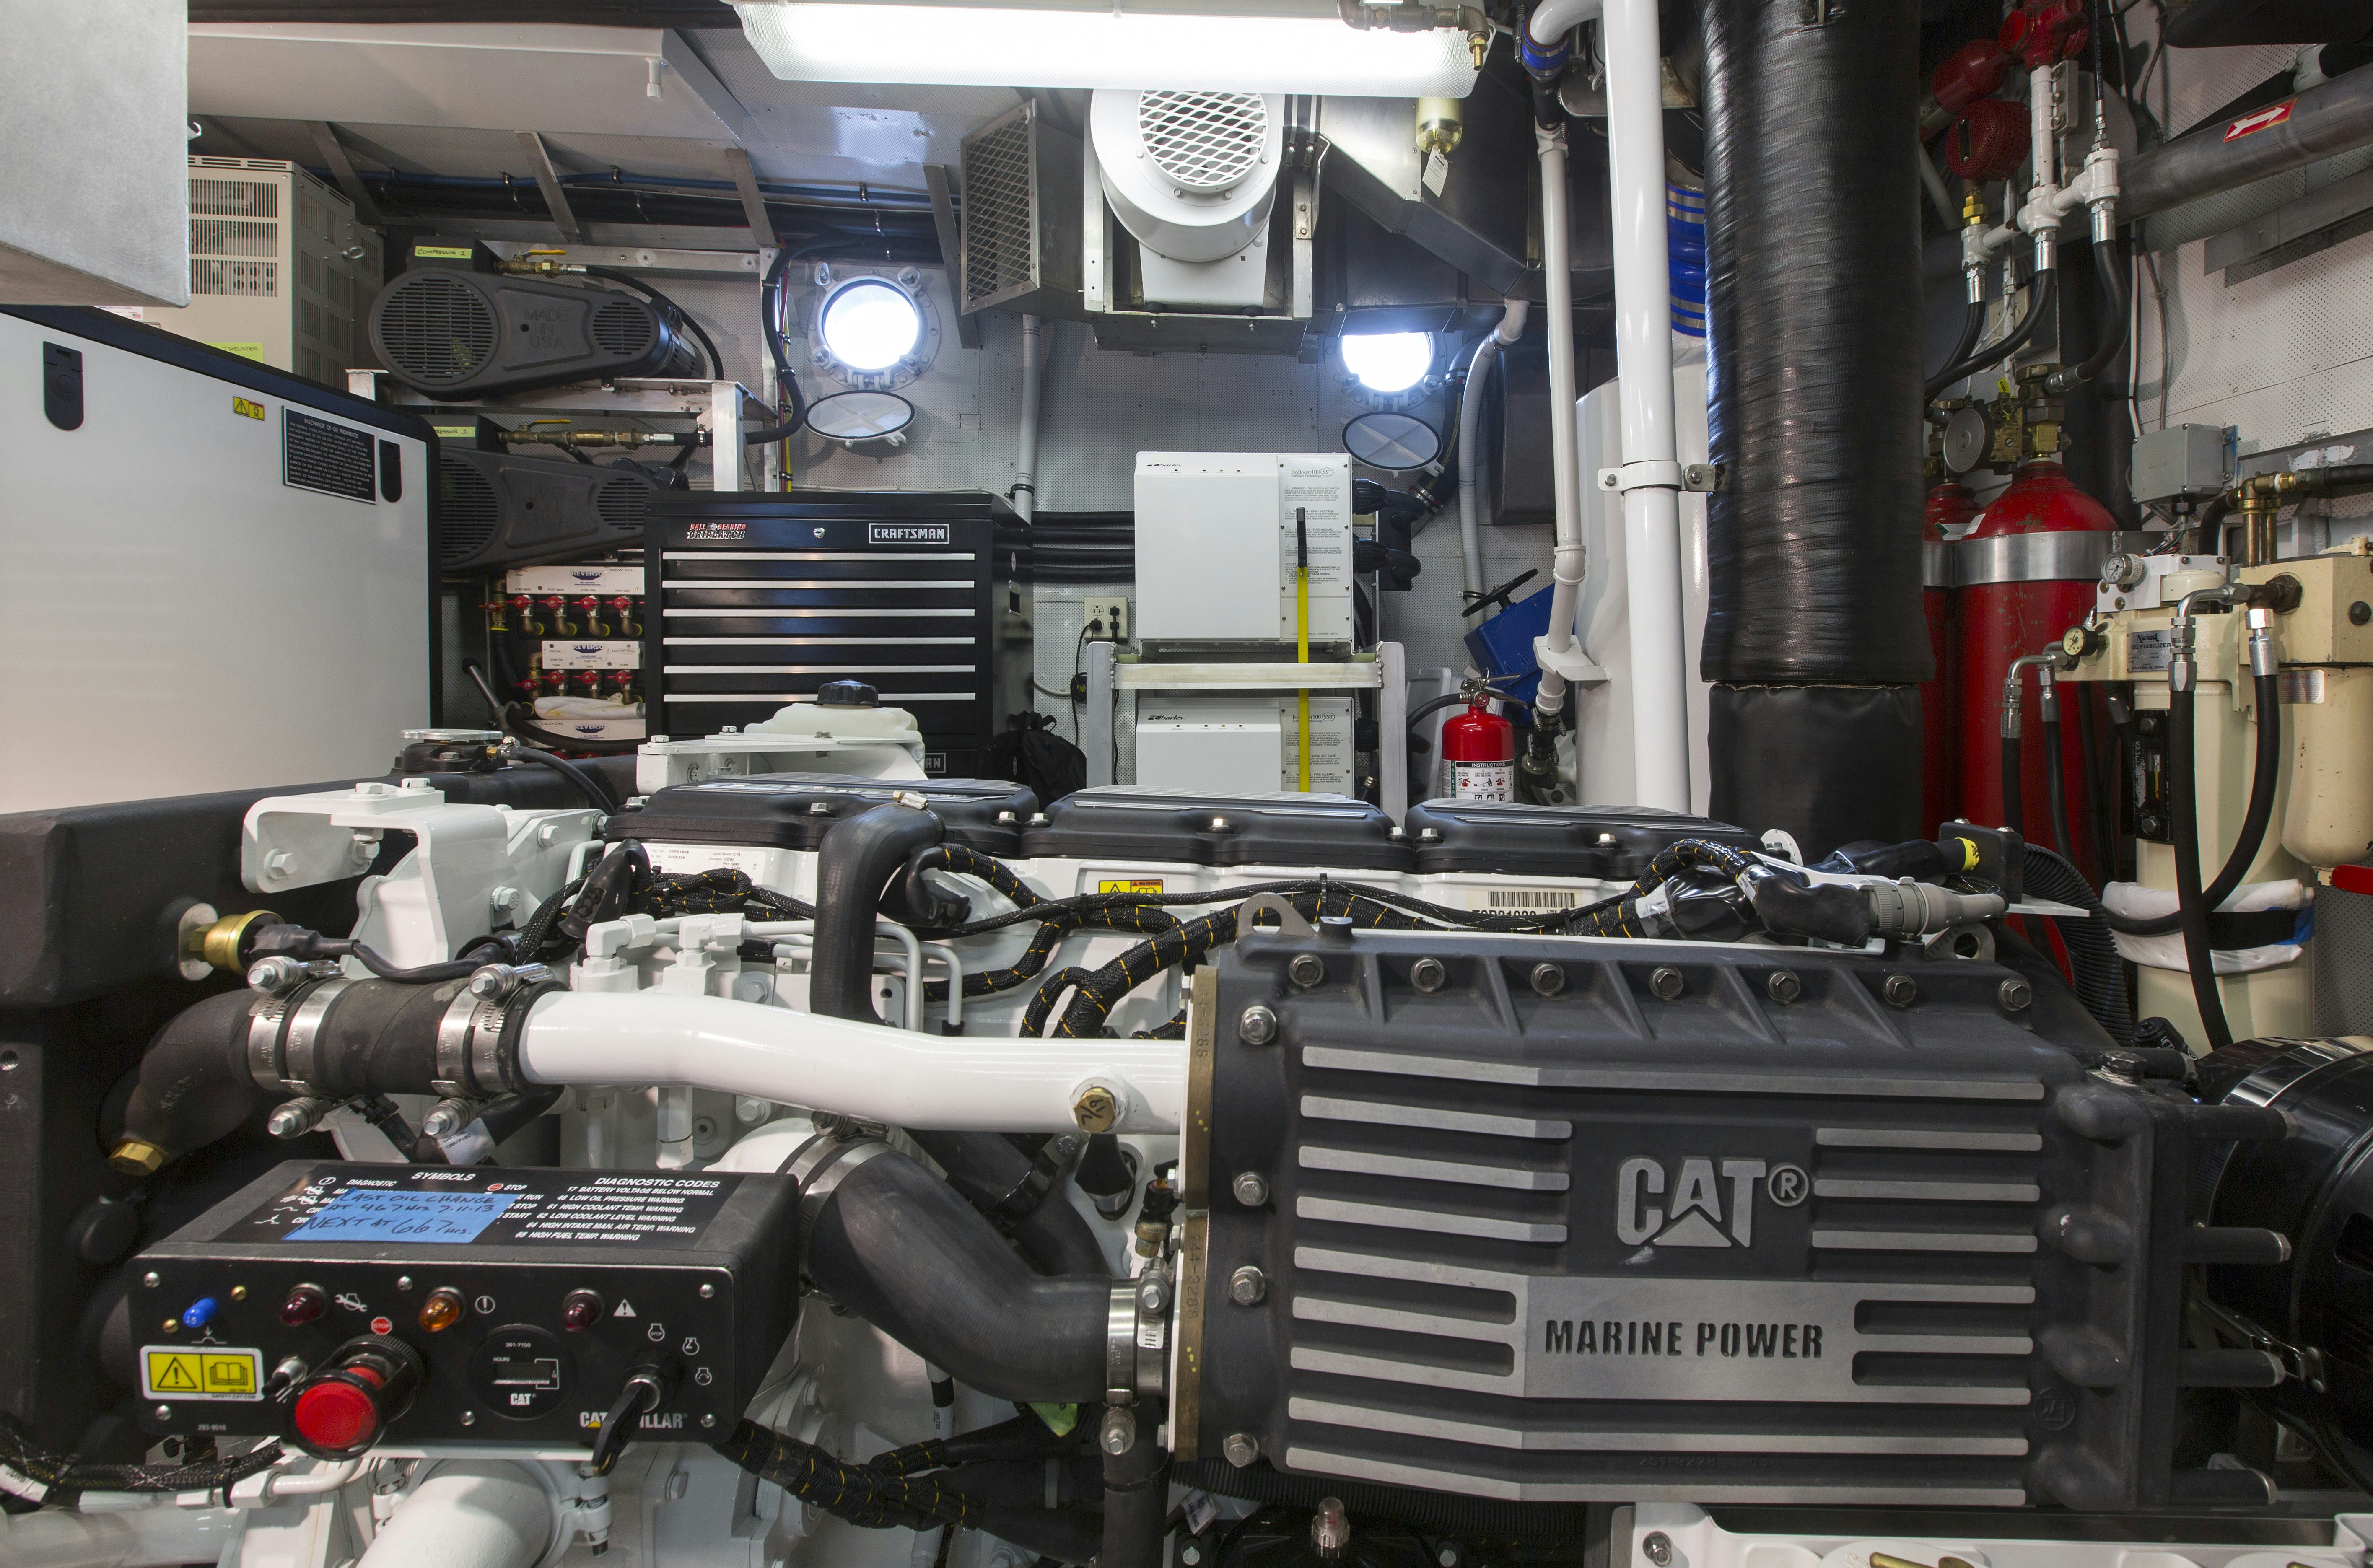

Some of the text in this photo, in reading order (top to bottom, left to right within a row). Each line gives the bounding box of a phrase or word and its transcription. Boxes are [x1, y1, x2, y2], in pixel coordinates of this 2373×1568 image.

[525, 309, 568, 322] MADE
[531, 336, 564, 348] USA
[304, 418, 325, 429] DISCHARGE
[340, 429, 359, 438] PROHIBITED
[874, 528, 945, 539] CRAFTSMAN
[2137, 633, 2159, 643] Naiad
[411, 1172, 476, 1182] SYMBOLS
[594, 1177, 721, 1188] DIAGNOSTIC CODES
[340, 1193, 380, 1203] LAST
[308, 1216, 366, 1230] NEXT
[371, 1218, 394, 1227] AT
[391, 1218, 449, 1234] 667
[186, 1315, 197, 1324] 15
[1545, 1319, 1824, 1359] MARINE POWER
